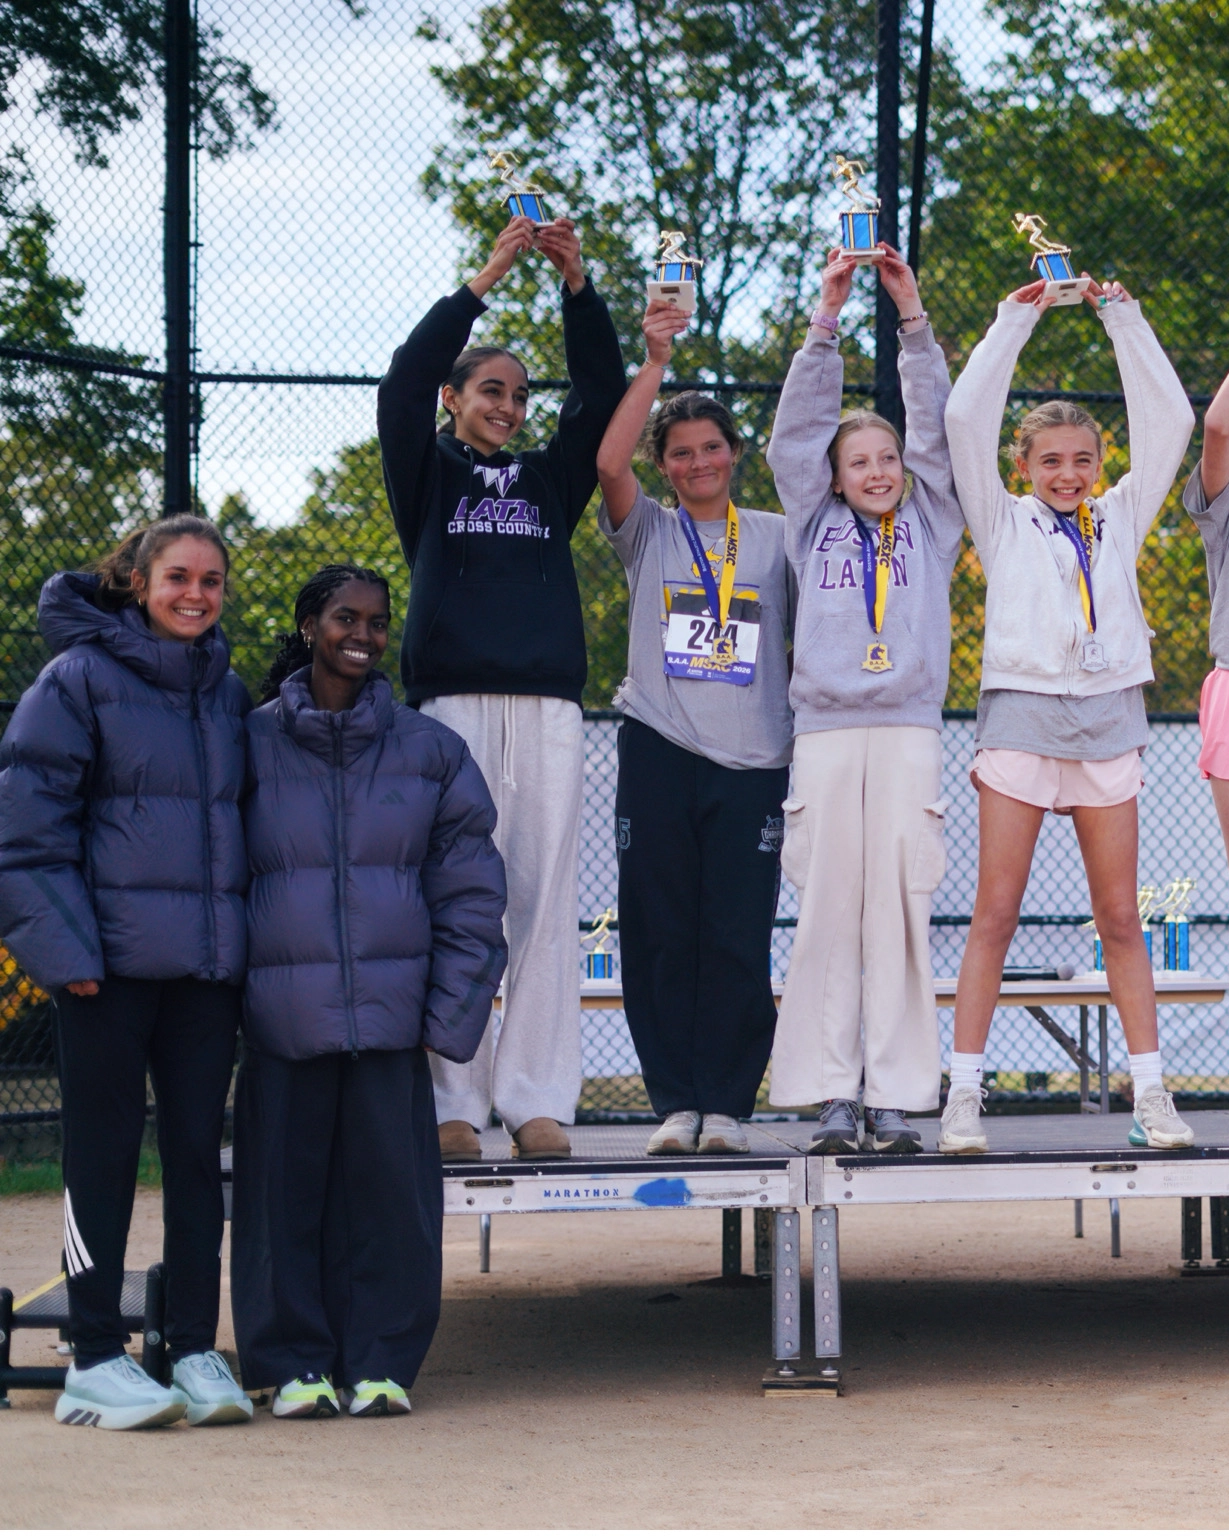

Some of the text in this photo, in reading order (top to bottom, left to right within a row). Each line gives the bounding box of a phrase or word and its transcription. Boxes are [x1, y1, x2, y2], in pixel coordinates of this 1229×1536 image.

[454, 496, 540, 526] LATIN
[447, 520, 493, 534] CROSS
[725, 537, 738, 567] MSXC
[880, 533, 892, 569] MSXC
[818, 553, 909, 590] LAN
[687, 619, 739, 652] 244
[667, 656, 689, 665] B.A.A.
[732, 665, 751, 674] 2026
[544, 1188, 619, 1198] MARATHON
